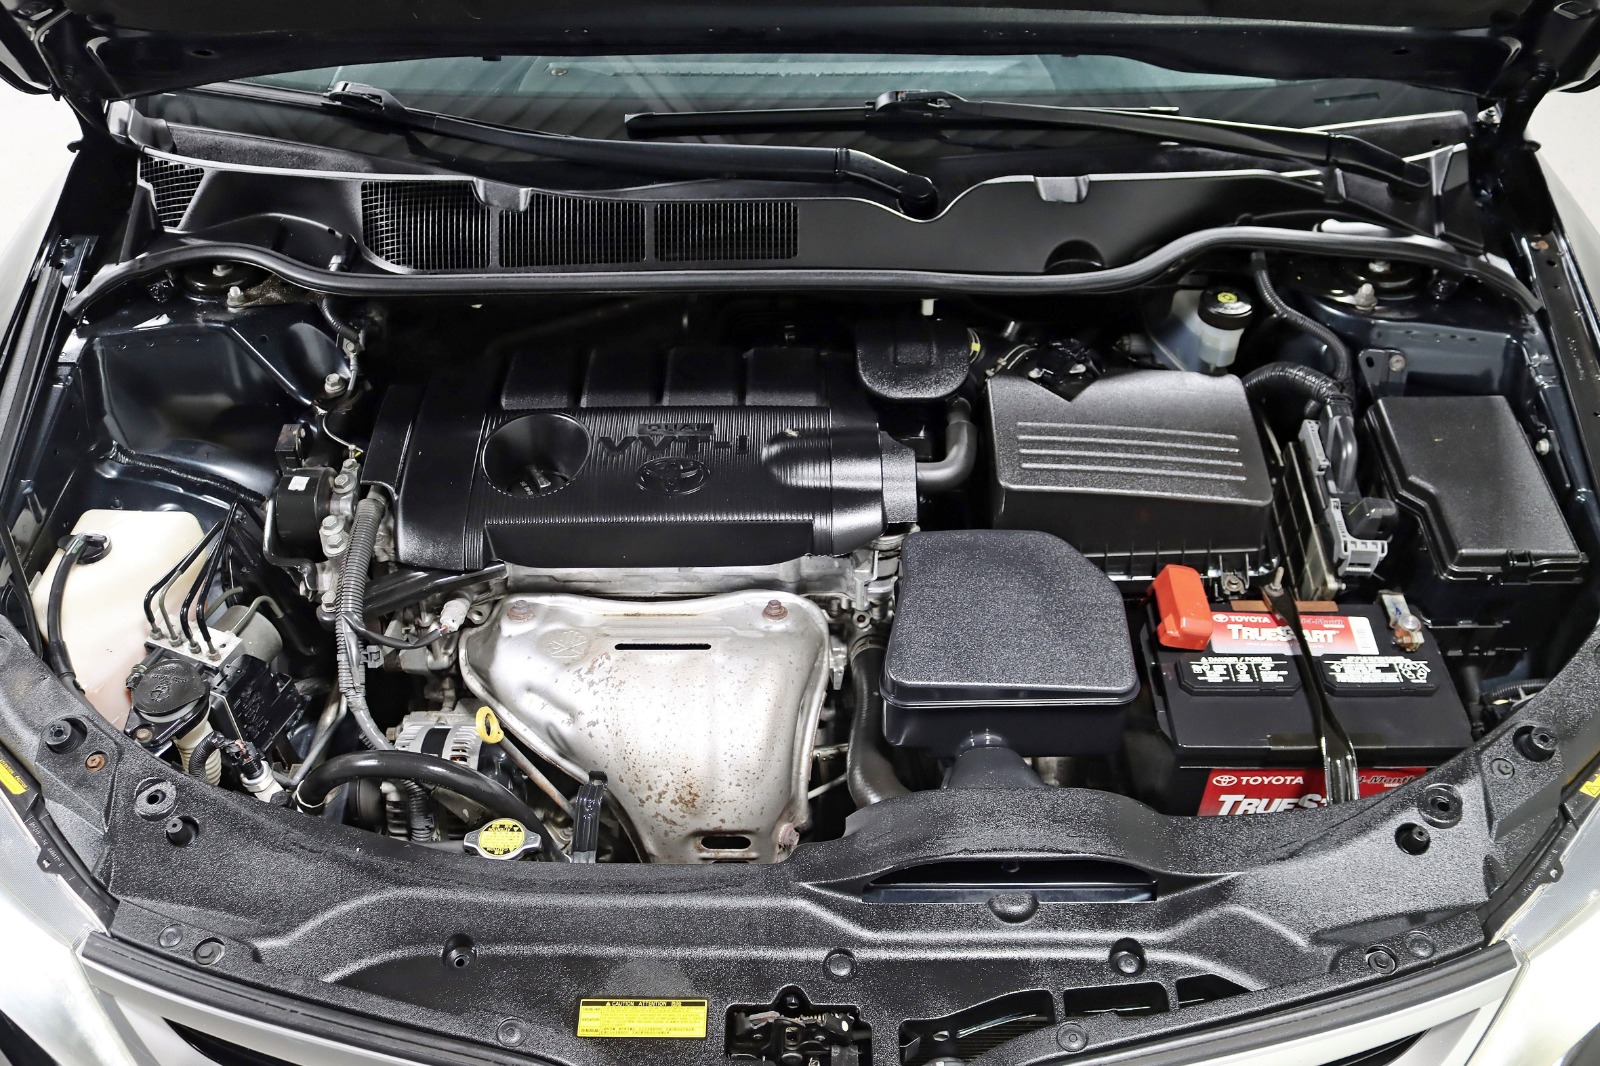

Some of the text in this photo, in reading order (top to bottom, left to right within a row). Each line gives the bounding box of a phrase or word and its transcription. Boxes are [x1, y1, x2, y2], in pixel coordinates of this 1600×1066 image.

[1228, 615, 1271, 623] TOYOTA
[1227, 624, 1339, 643] TRUESART
[1241, 776, 1304, 785] TOYOTA
